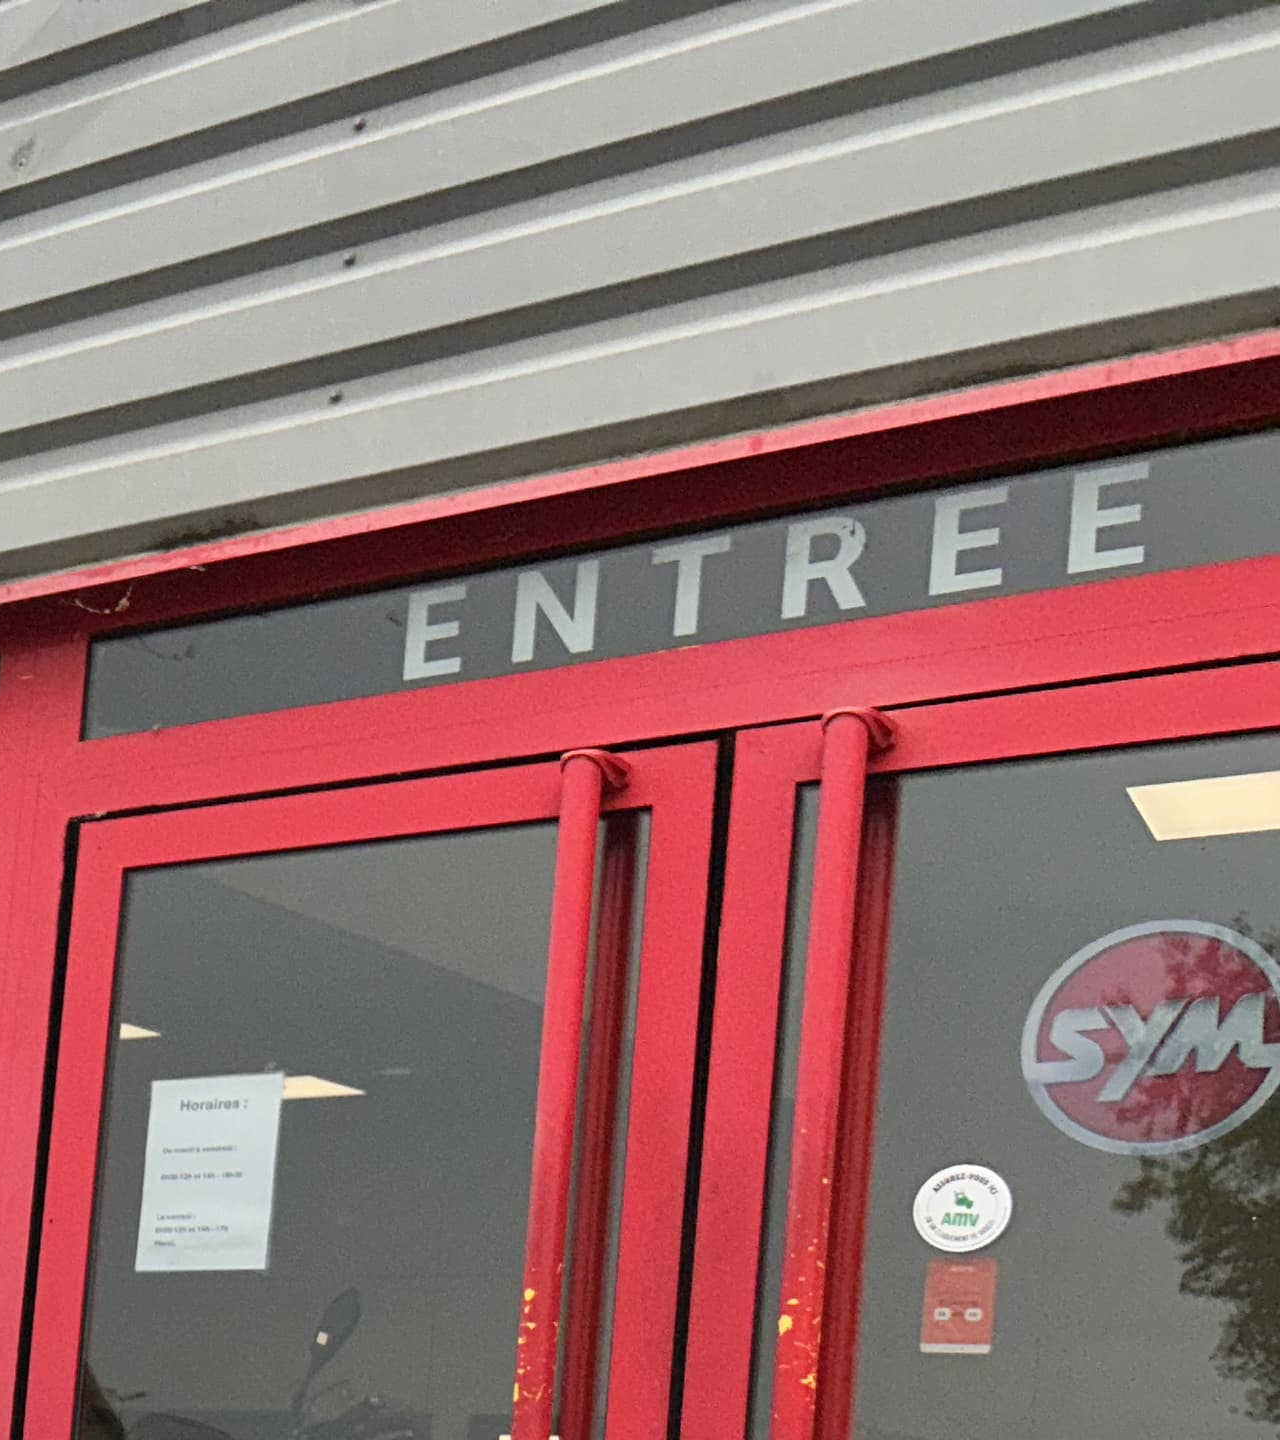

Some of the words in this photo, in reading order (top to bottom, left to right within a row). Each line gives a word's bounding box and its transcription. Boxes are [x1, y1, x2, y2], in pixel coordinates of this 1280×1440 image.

[402, 461, 1151, 682] ENTREE
[1034, 990, 1280, 1102] SYM
[179, 1097, 240, 1113] Horaires
